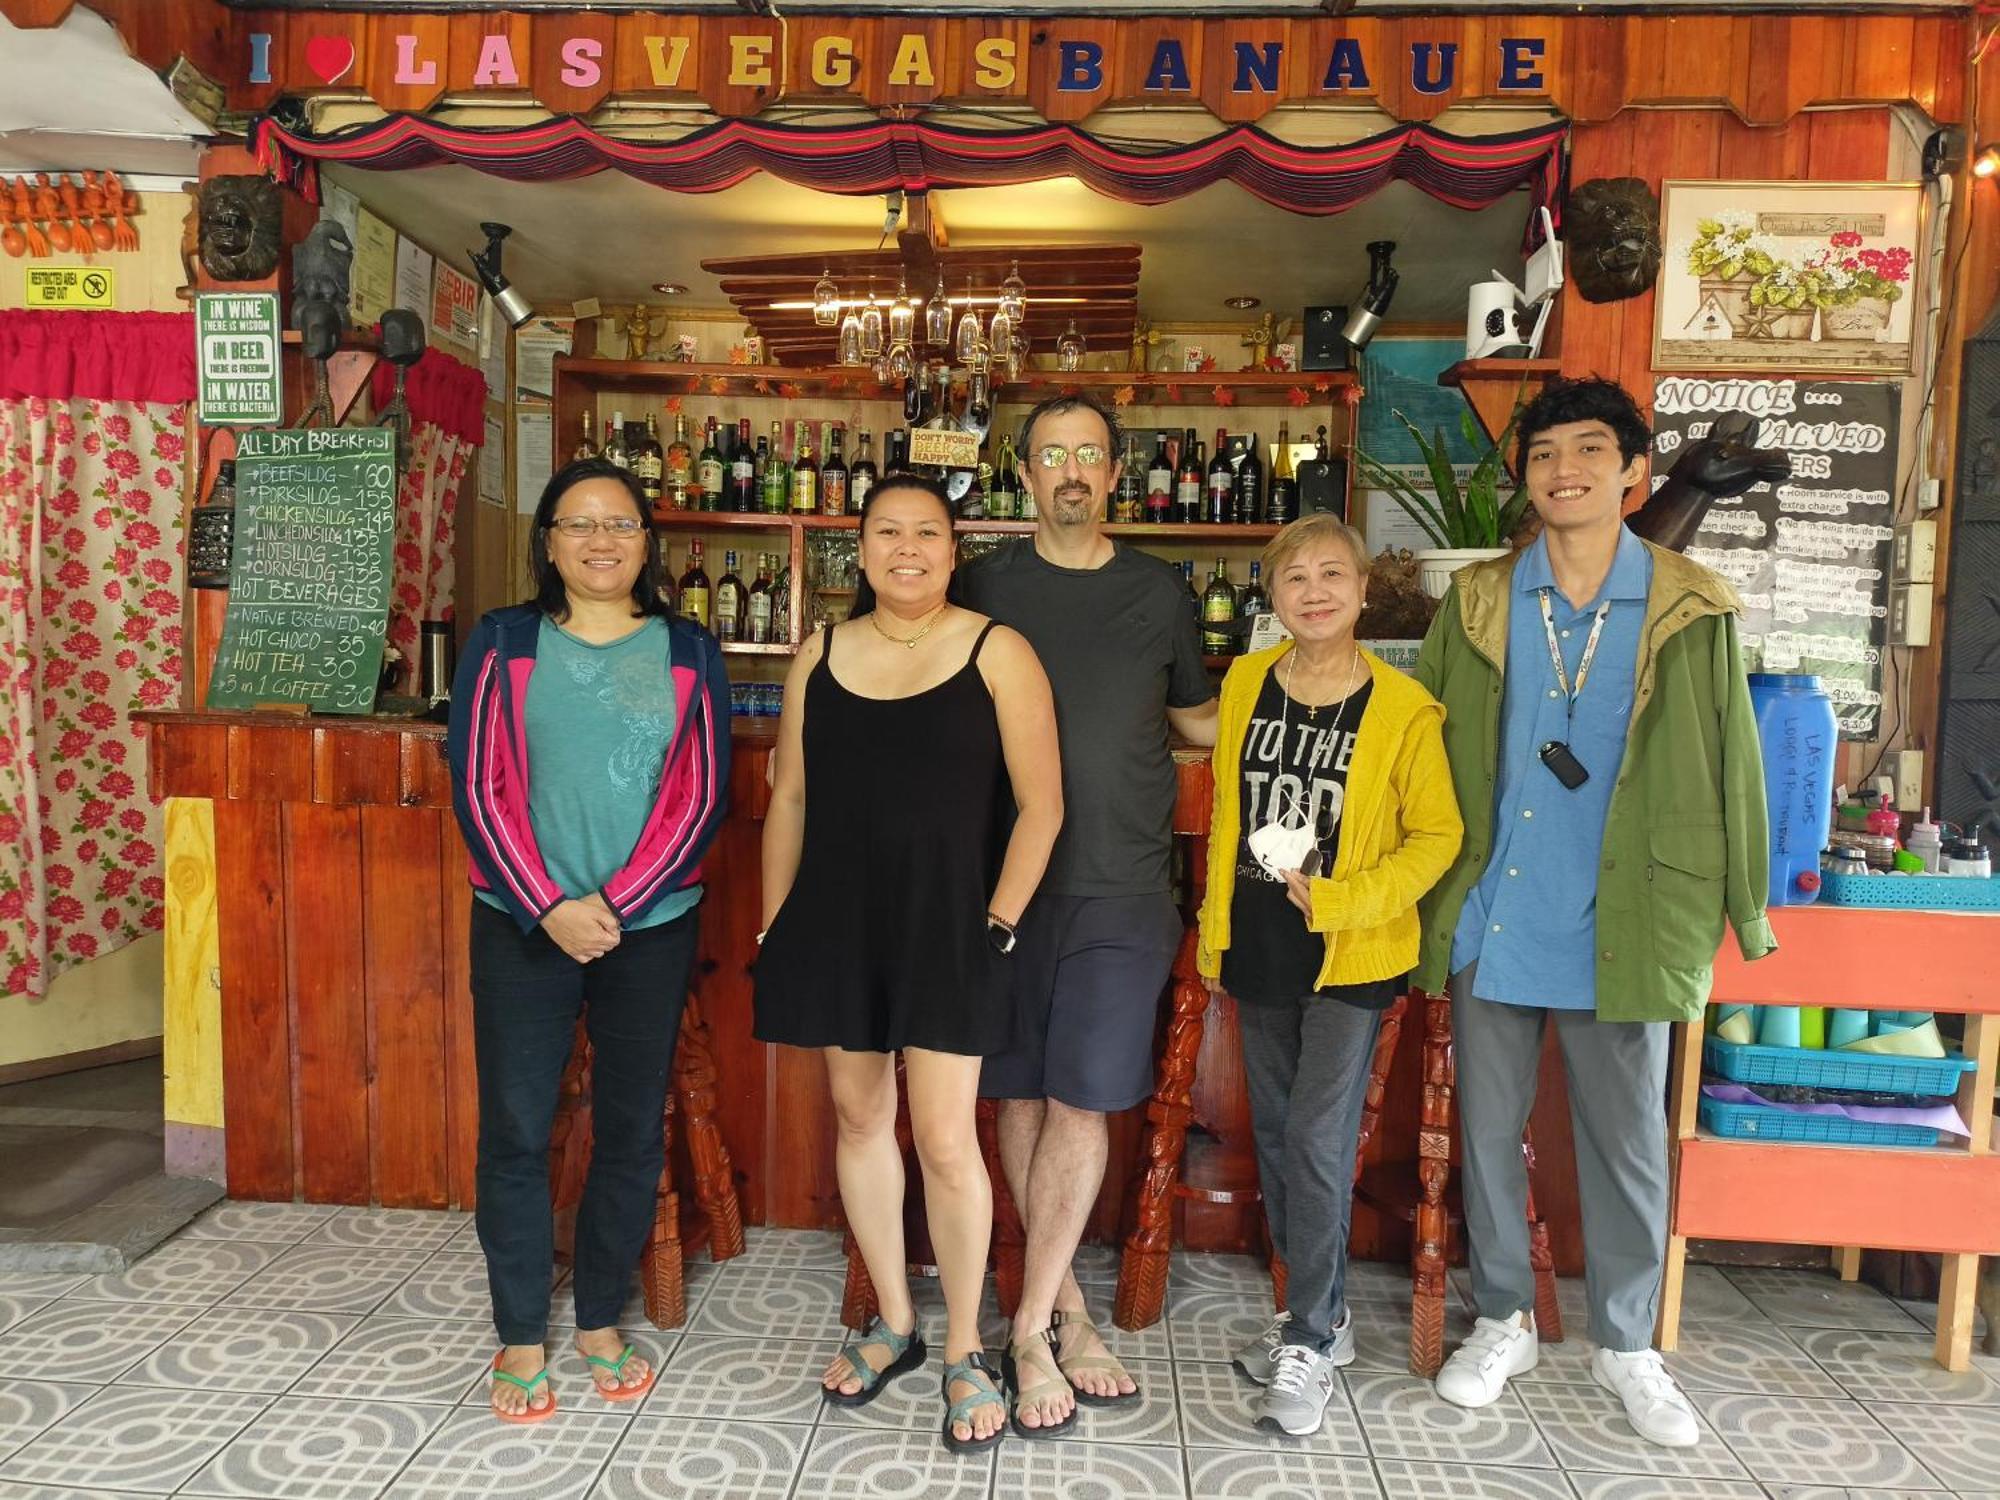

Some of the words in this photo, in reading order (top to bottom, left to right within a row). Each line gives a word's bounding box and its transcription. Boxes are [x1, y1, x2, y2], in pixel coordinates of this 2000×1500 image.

[43, 286, 56, 300] KEEP
[57, 286, 68, 300] OUT
[454, 276, 475, 313] BIR
[204, 320, 228, 331] THERE
[231, 341, 265, 360] BEER
[210, 364, 229, 374] THERE
[226, 382, 271, 401] WATER
[1658, 381, 1793, 413] NOTICE
[204, 401, 228, 412] THERE
[239, 401, 275, 413] BACTERIA
[916, 442, 950, 453] BEER
[1660, 431, 1678, 451] to
[914, 453, 950, 462] HAPPY
[258, 463, 337, 484] BEEFSILOG
[258, 485, 341, 505] PORKSILOG
[1780, 501, 1806, 509] extra
[1818, 490, 1853, 500] service
[1866, 492, 1887, 502] with
[254, 505, 355, 525] CHICKENSILOG
[1727, 511, 1738, 519] at
[1739, 511, 1756, 520] the
[256, 541, 326, 563] HOTSILOG
[230, 575, 265, 600] HOT
[266, 580, 382, 609] BEVERAGES
[241, 608, 286, 626] NATIVE
[291, 611, 360, 633] BREWED
[238, 629, 268, 648] HOT
[267, 631, 321, 650] CHOCO
[337, 635, 366, 657] 35
[233, 650, 266, 671] HOT
[267, 652, 305, 673] TEA
[1245, 718, 1287, 762] TO
[1292, 723, 1358, 772] THE
[1804, 733, 1823, 767] LAS
[1245, 771, 1345, 838] TOP
[1237, 865, 1275, 883] CHICAG
